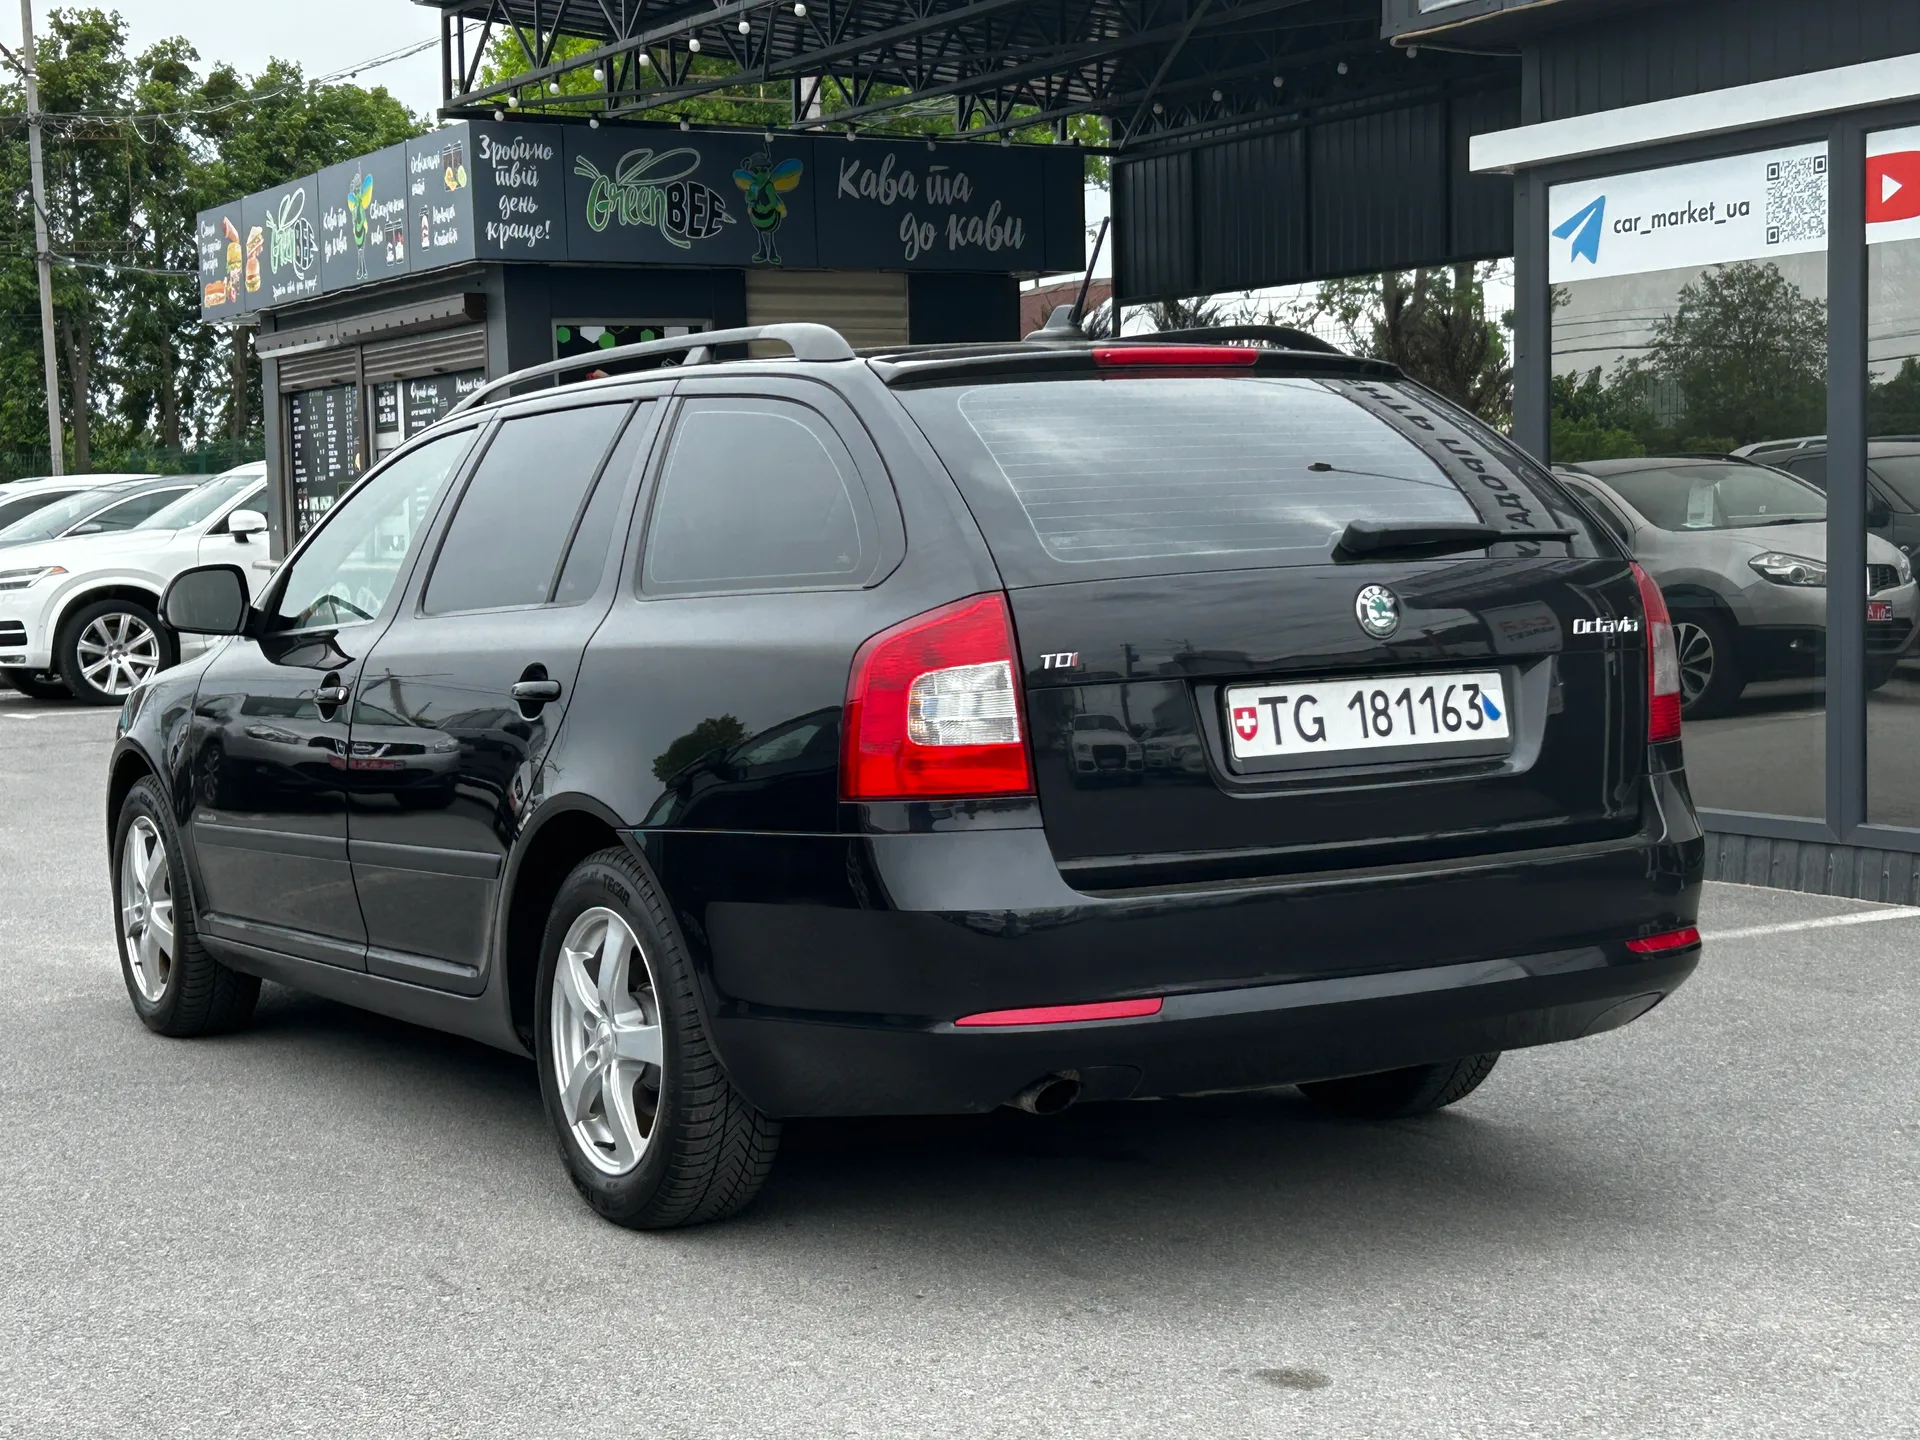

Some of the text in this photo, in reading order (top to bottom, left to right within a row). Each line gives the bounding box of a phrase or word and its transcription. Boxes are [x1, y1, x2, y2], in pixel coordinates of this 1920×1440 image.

[479, 135, 554, 168] Зробимо
[495, 161, 540, 188] твій
[837, 152, 974, 206] Кава та
[498, 192, 539, 221] день
[1613, 200, 1751, 235] car_market_ua
[485, 219, 551, 250] краще!
[899, 199, 1026, 262] до кави
[1572, 616, 1639, 635] Octavia
[1258, 683, 1484, 746] TG 181163
